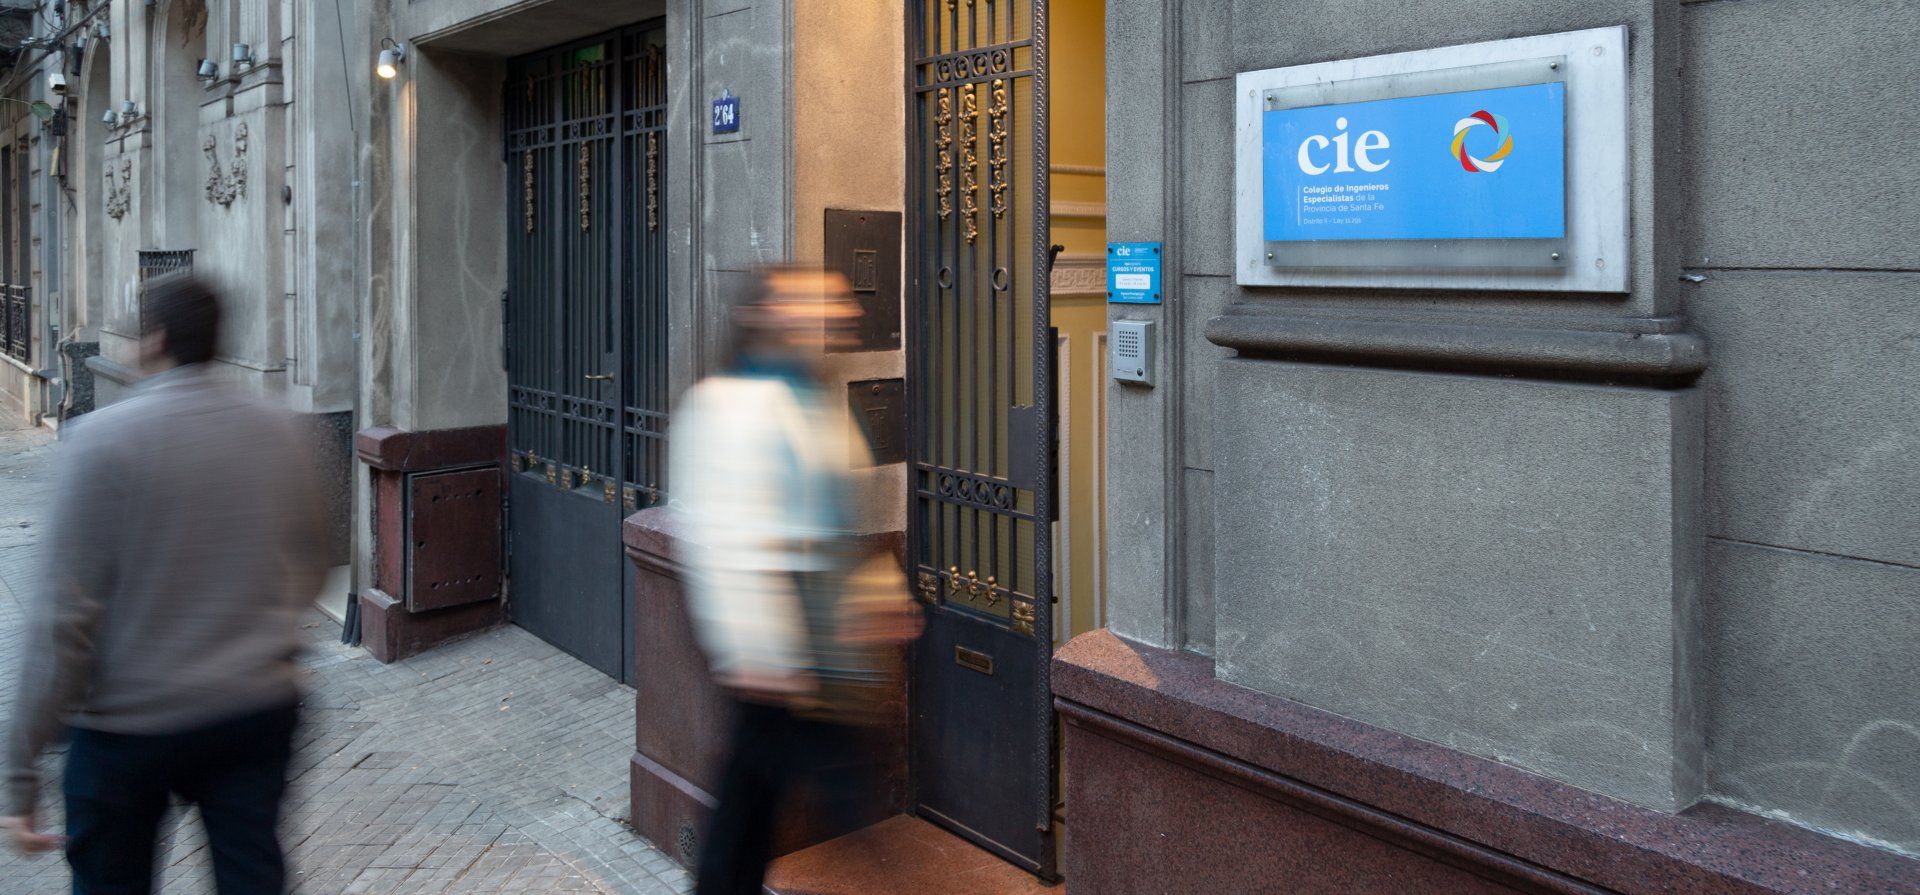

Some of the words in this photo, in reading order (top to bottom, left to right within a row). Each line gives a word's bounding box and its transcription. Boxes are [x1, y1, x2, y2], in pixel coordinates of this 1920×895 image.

[1297, 116, 1390, 176] cie
[1303, 186, 1332, 194] Colegio
[1346, 184, 1389, 193] Ingenieros
[1303, 194, 1354, 204] Especialistas
[1355, 194, 1366, 202] de
[1367, 193, 1375, 201] la
[1303, 204, 1336, 212] Provincia
[1338, 204, 1349, 212] de
[1350, 203, 1372, 212] Santa
[1374, 202, 1384, 211] Fe
[1117, 246, 1131, 256] cie
